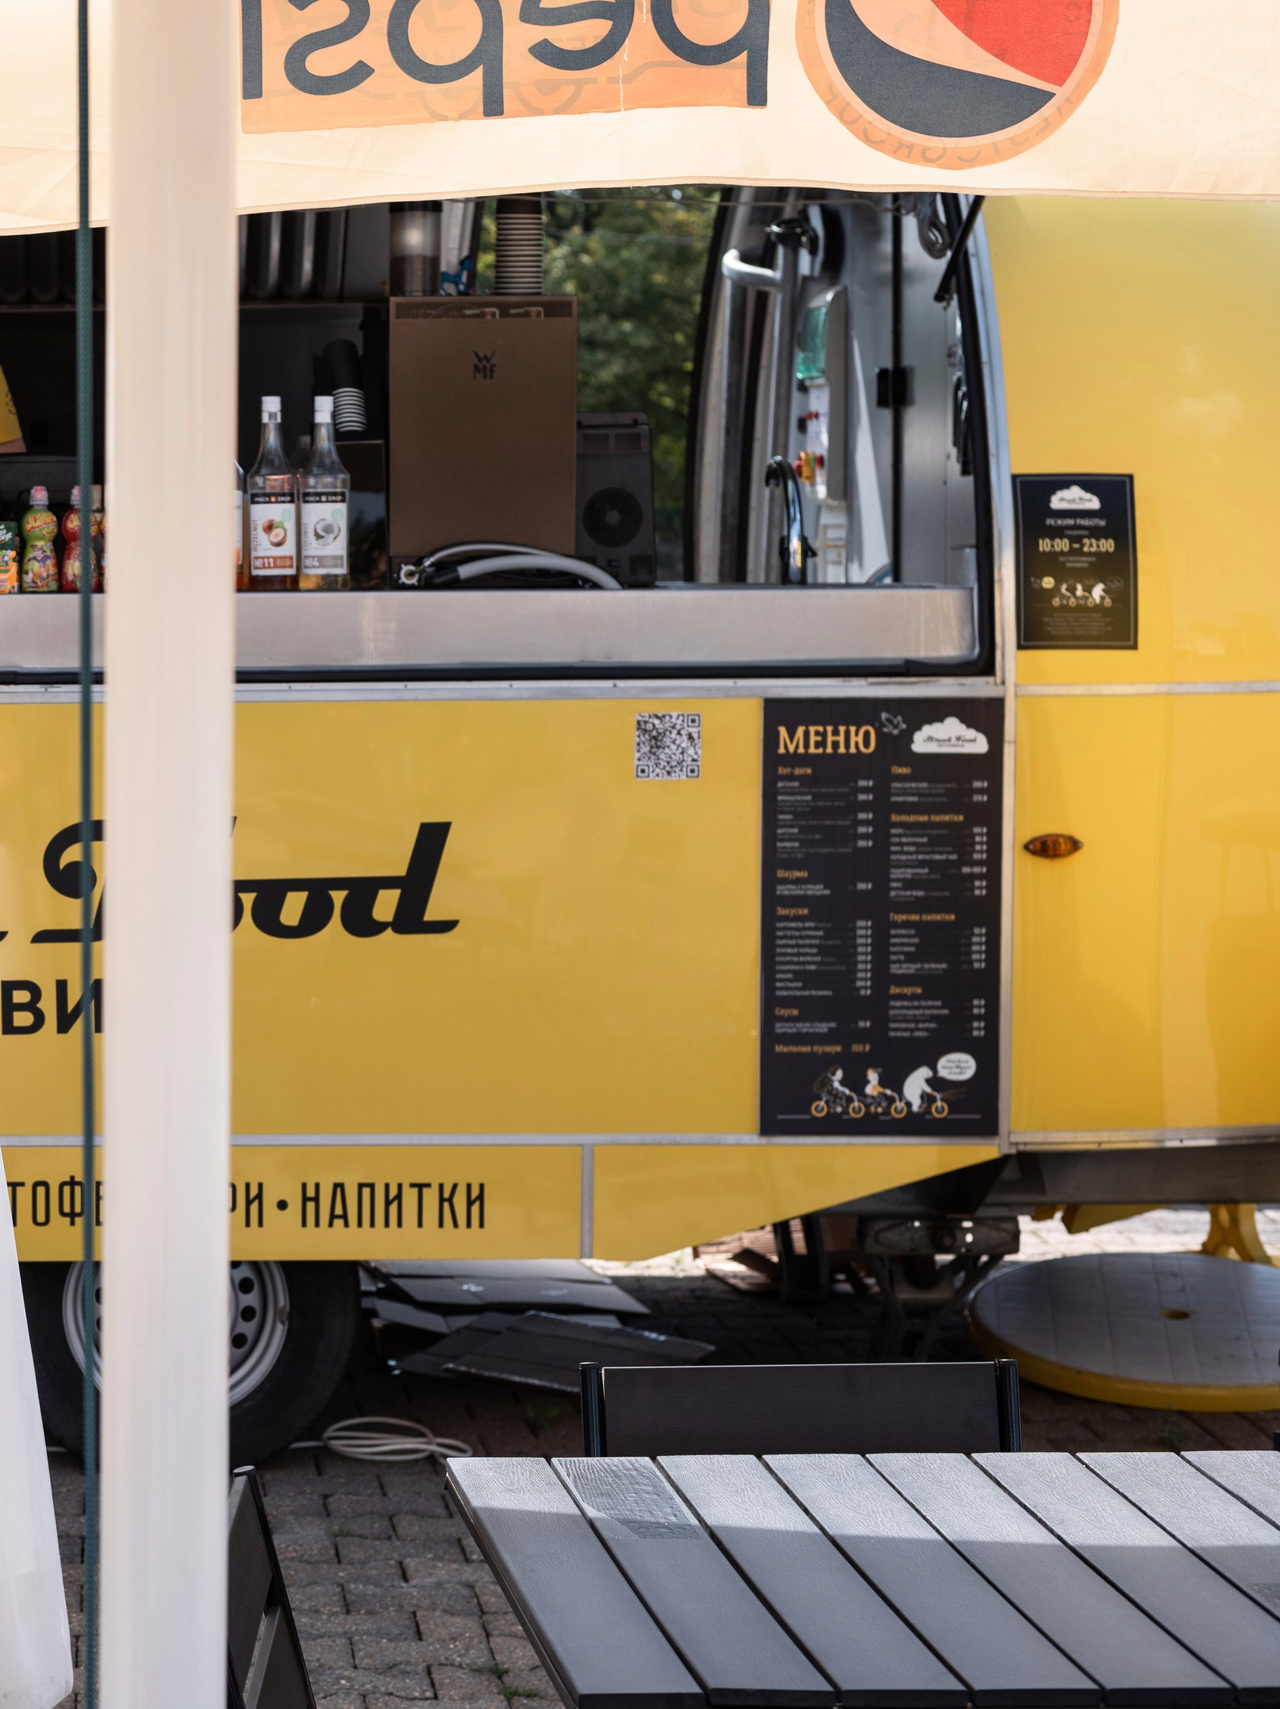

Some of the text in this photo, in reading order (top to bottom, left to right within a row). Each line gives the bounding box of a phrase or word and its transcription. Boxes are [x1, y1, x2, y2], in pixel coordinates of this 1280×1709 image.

[1038, 537, 1070, 553] 10:00
[1081, 538, 1115, 553] 23:00
[777, 725, 876, 754] МЕНЮ
[301, 1181, 485, 1229] НАПИТКИ
